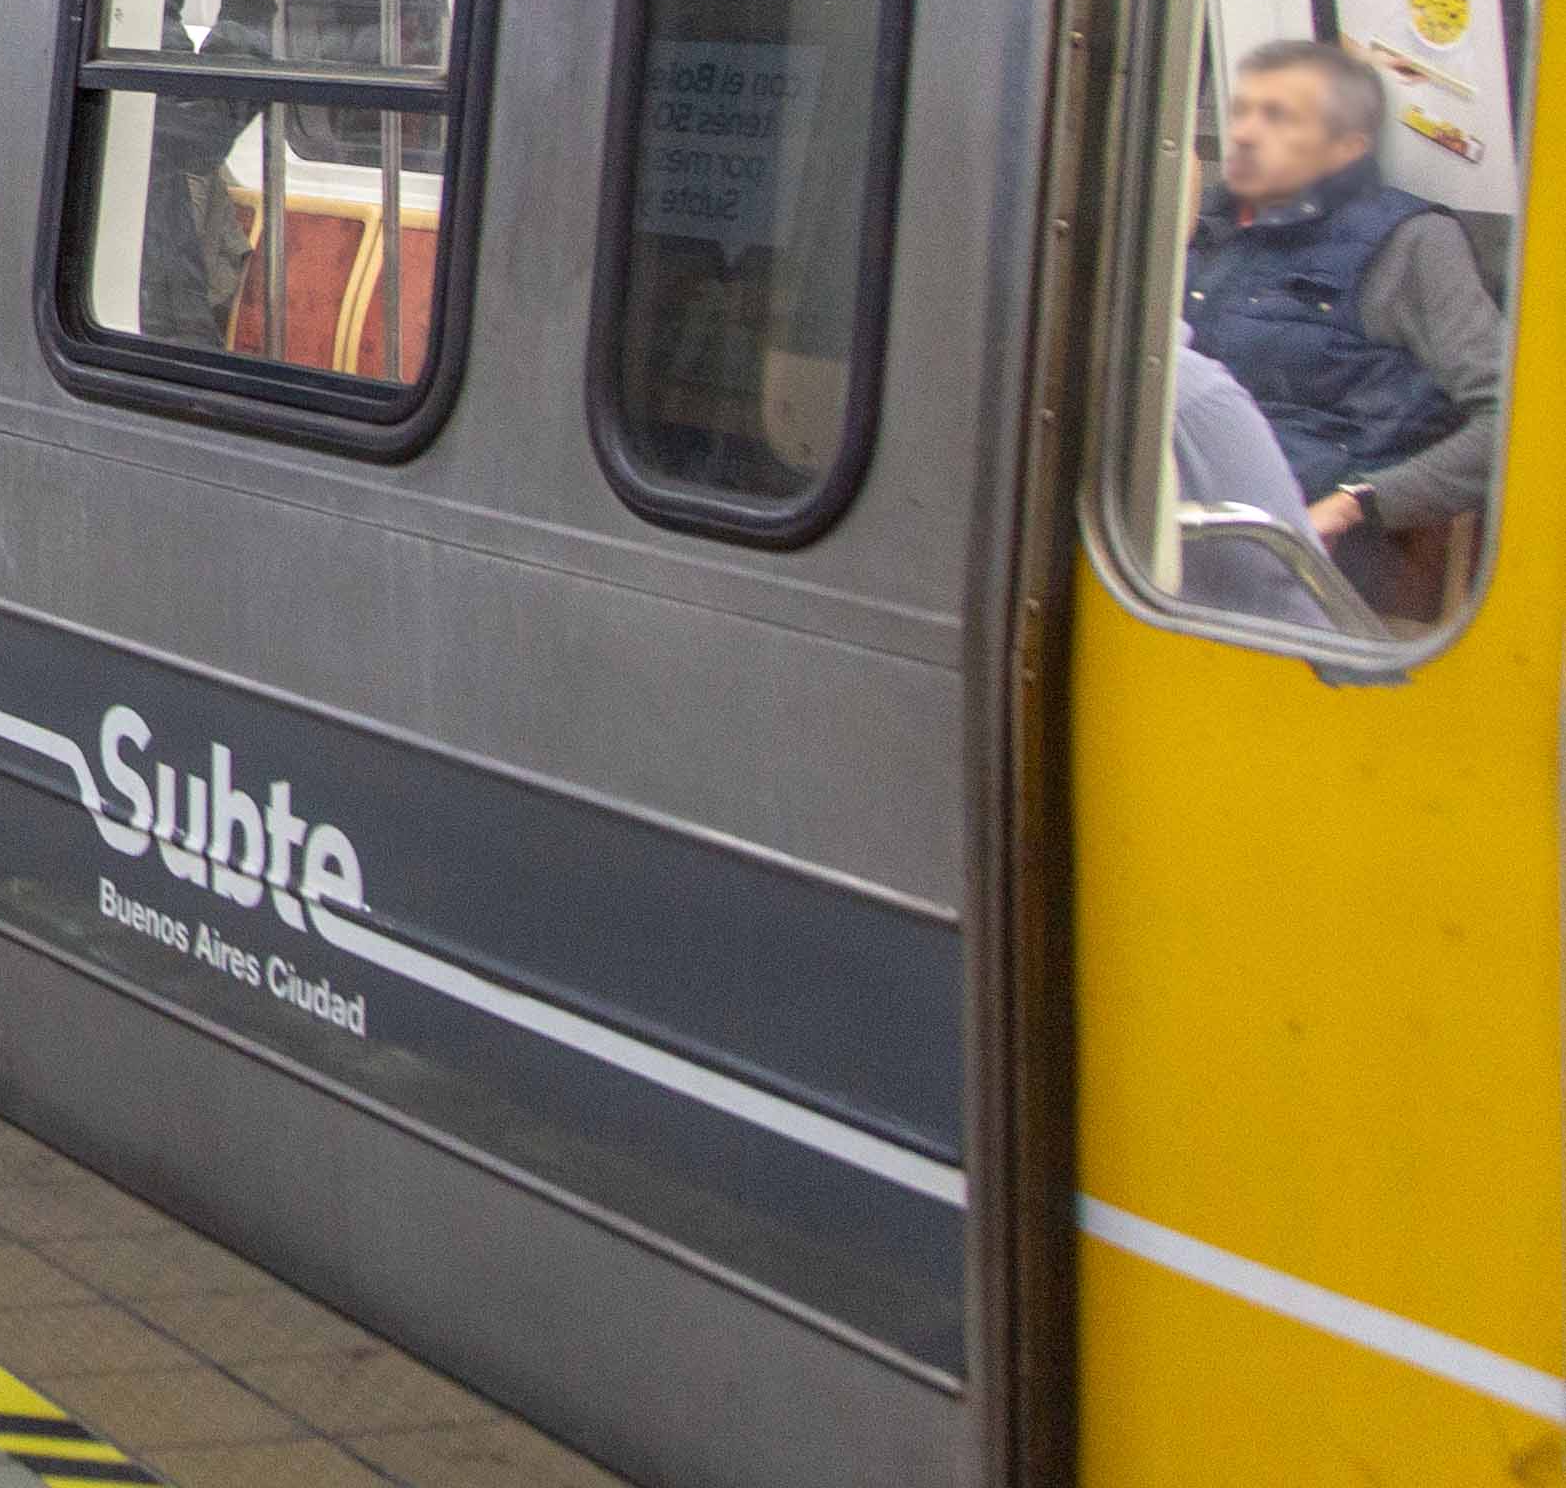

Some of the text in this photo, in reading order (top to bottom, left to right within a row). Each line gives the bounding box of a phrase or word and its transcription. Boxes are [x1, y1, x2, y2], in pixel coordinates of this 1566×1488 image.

[92, 704, 367, 942] Subte
[99, 876, 366, 1038] Buenos Aires Ciudad
